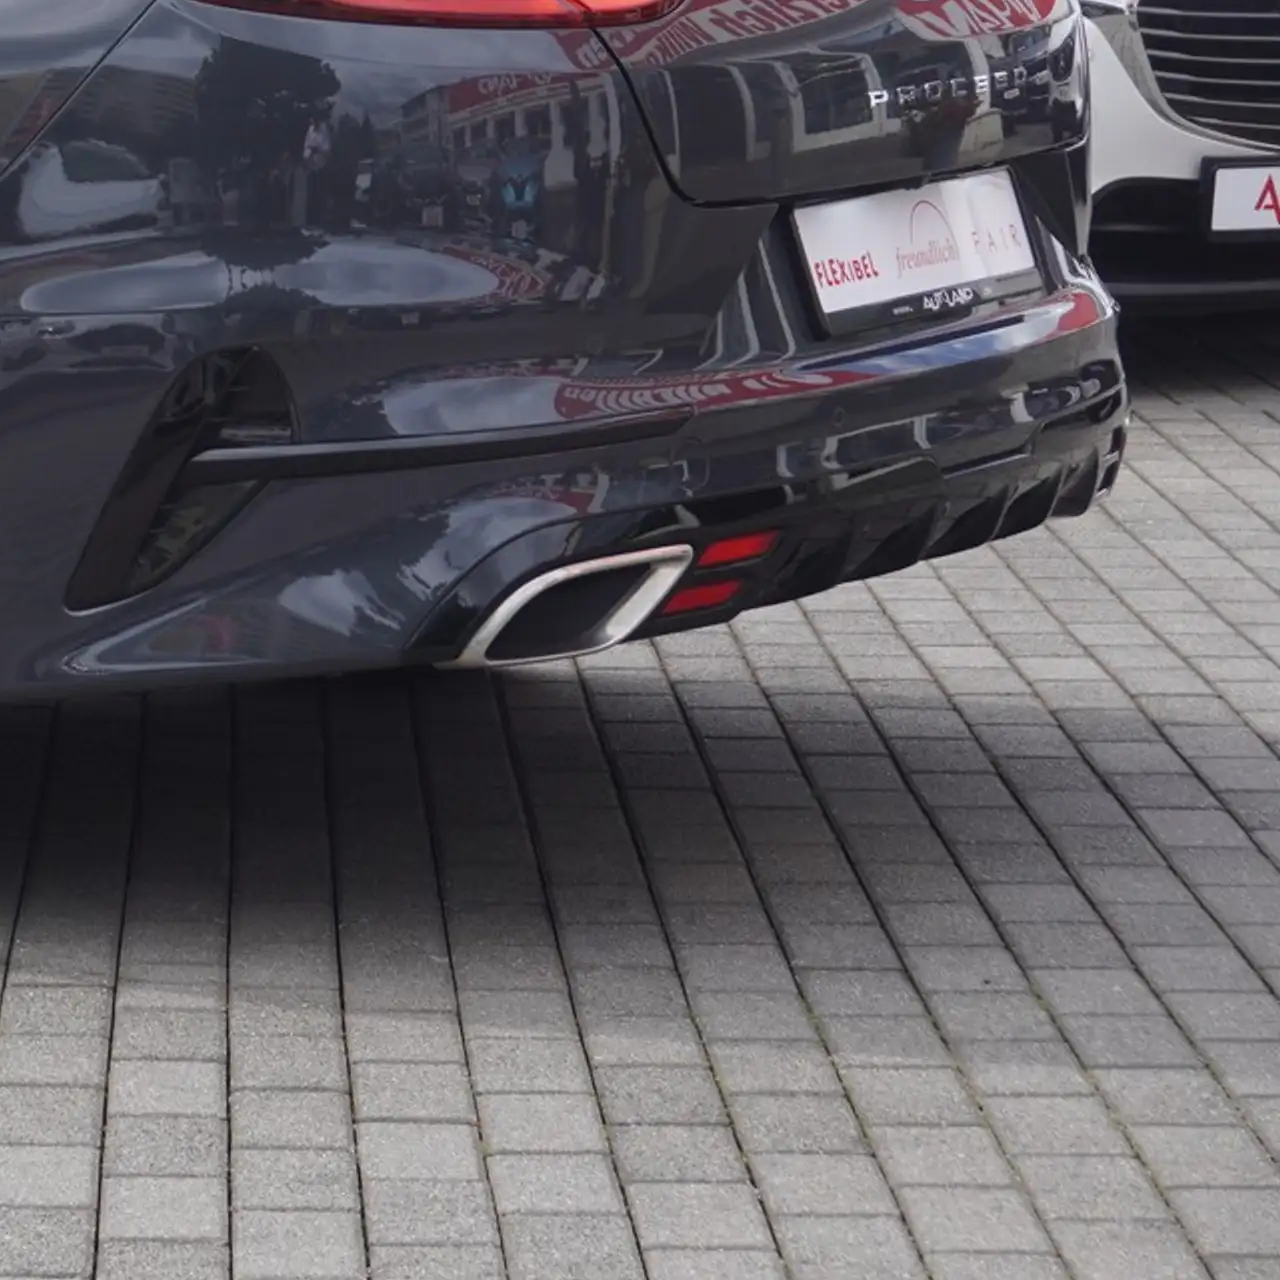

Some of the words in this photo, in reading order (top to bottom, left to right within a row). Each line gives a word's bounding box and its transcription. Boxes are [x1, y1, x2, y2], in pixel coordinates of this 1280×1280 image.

[813, 250, 881, 289] FLEXIBEL
[896, 236, 960, 280] freundlich
[971, 223, 1022, 255] FAIR
